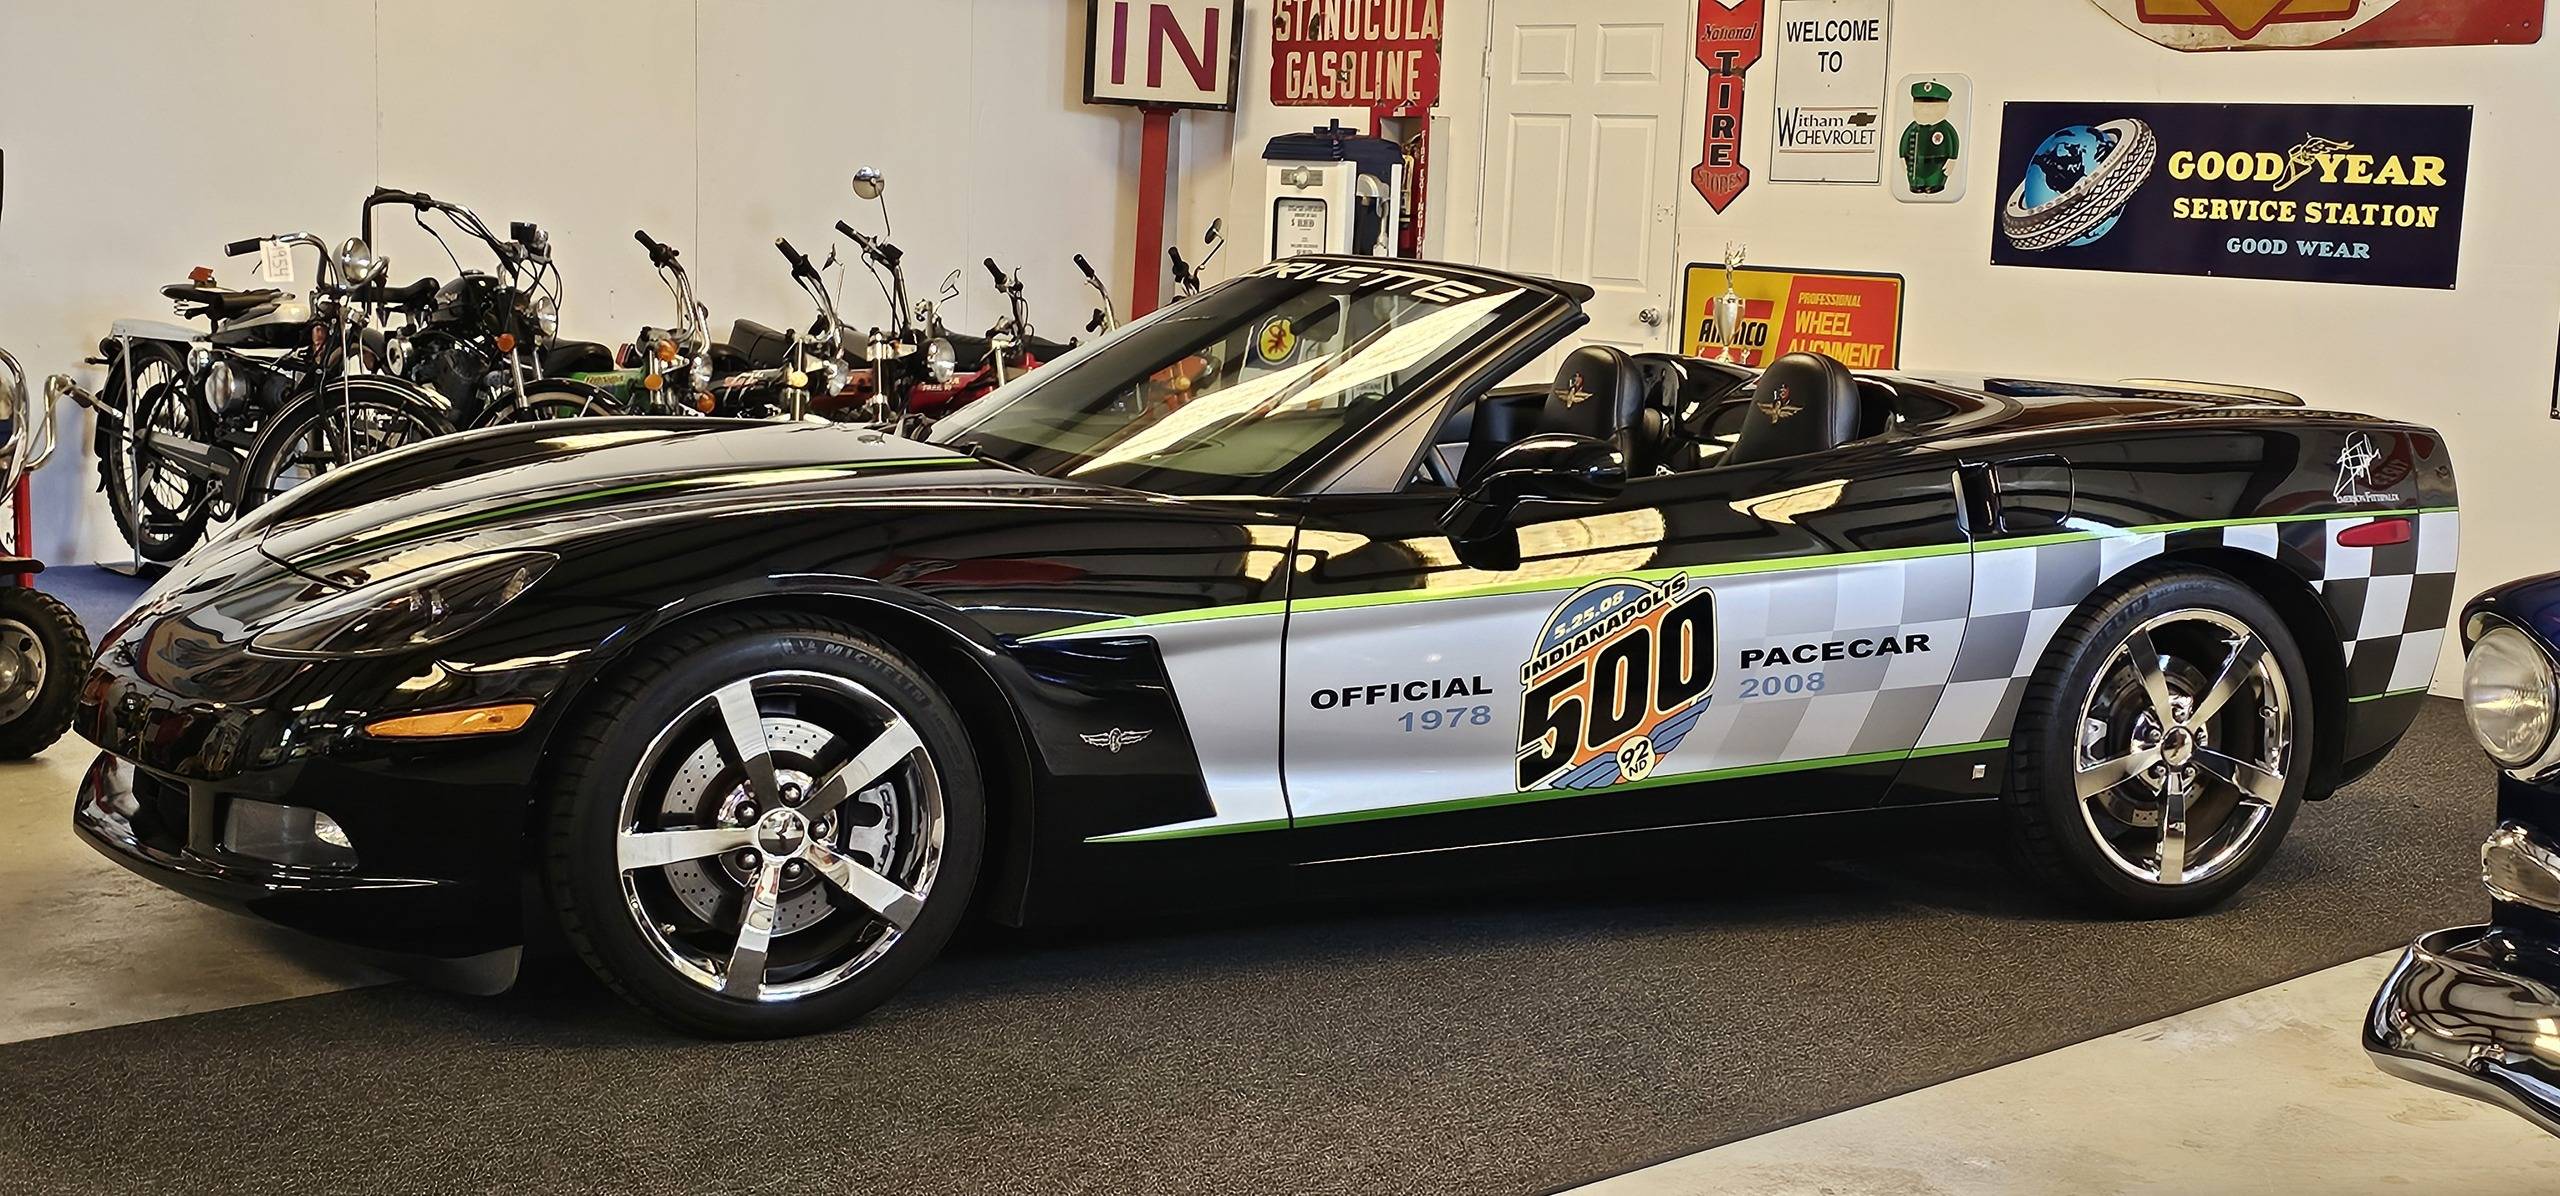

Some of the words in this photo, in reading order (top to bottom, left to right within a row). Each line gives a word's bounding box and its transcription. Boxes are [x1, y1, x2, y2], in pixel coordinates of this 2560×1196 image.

[1701, 22, 1758, 41] National
[1787, 19, 1879, 42] WELCOME
[1111, 2, 1219, 92] IN
[1818, 50, 1843, 73] TO
[1286, 50, 1422, 100] GASOLINE
[1709, 50, 1741, 168] TIRE
[1777, 107, 1844, 147] Witham
[1795, 129, 1876, 145] CHEVROLET
[1697, 170, 1743, 194] STORES
[2173, 197, 2297, 222] SERVICE
[2305, 202, 2439, 228] STATION
[2226, 237, 2288, 254] GOOD
[2296, 240, 2371, 259] WEAR
[1798, 292, 1862, 307] PROFESSIONAL
[1795, 310, 1853, 336] WHEEL
[1523, 573, 1687, 681] INDIANAPOLIS
[1553, 590, 1625, 641] 5.25.08
[1740, 634, 1931, 669] PACECAR
[823, 642, 932, 705] MICHELIN
[1739, 672, 1825, 698] 2008
[1310, 675, 1493, 710] OFFICIAL
[1518, 590, 1715, 789] 500
[1398, 705, 1492, 732] 1978
[1621, 740, 1650, 769] 92
[1628, 759, 1647, 777] ND
